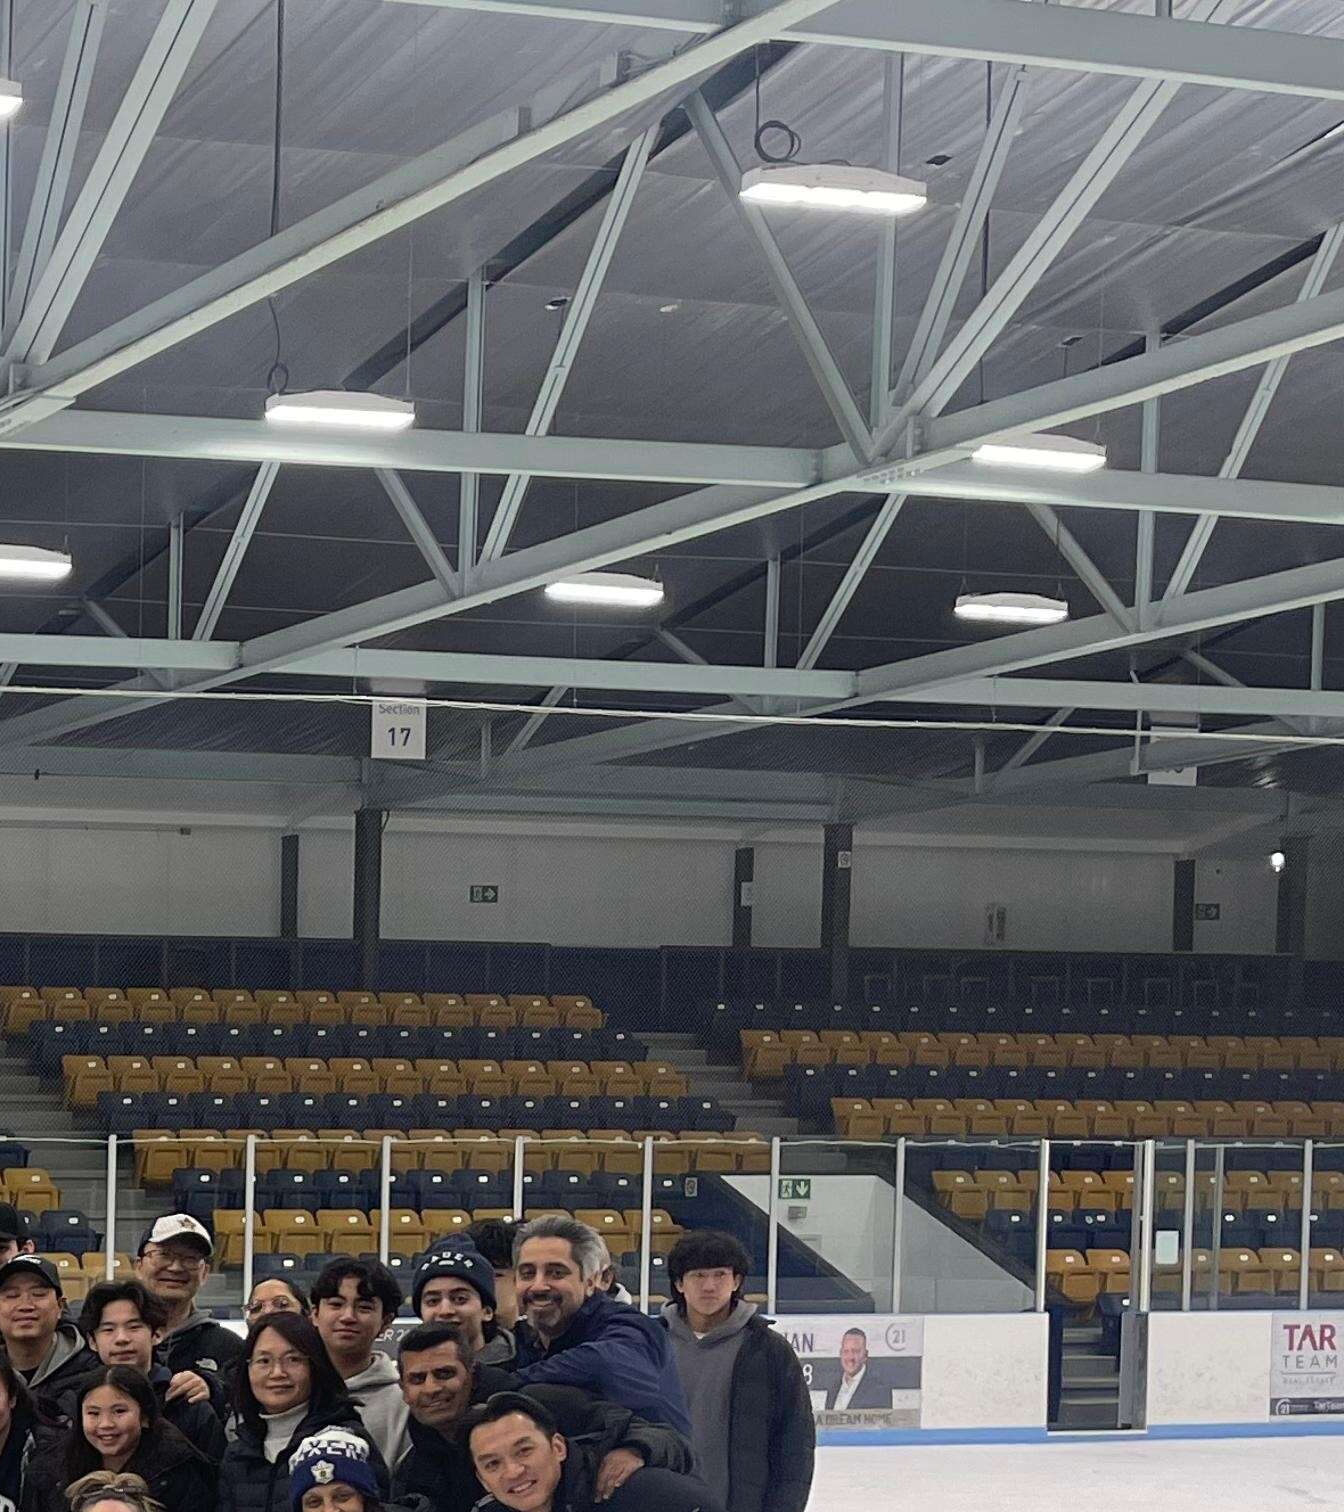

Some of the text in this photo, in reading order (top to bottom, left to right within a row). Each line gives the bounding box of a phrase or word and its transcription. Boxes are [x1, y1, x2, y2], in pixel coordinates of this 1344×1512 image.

[379, 703, 420, 716] Section
[388, 727, 411, 746] 17
[785, 1333, 814, 1353] AN
[1283, 1324, 1336, 1351] TAR
[1282, 1355, 1338, 1369] TEAM
